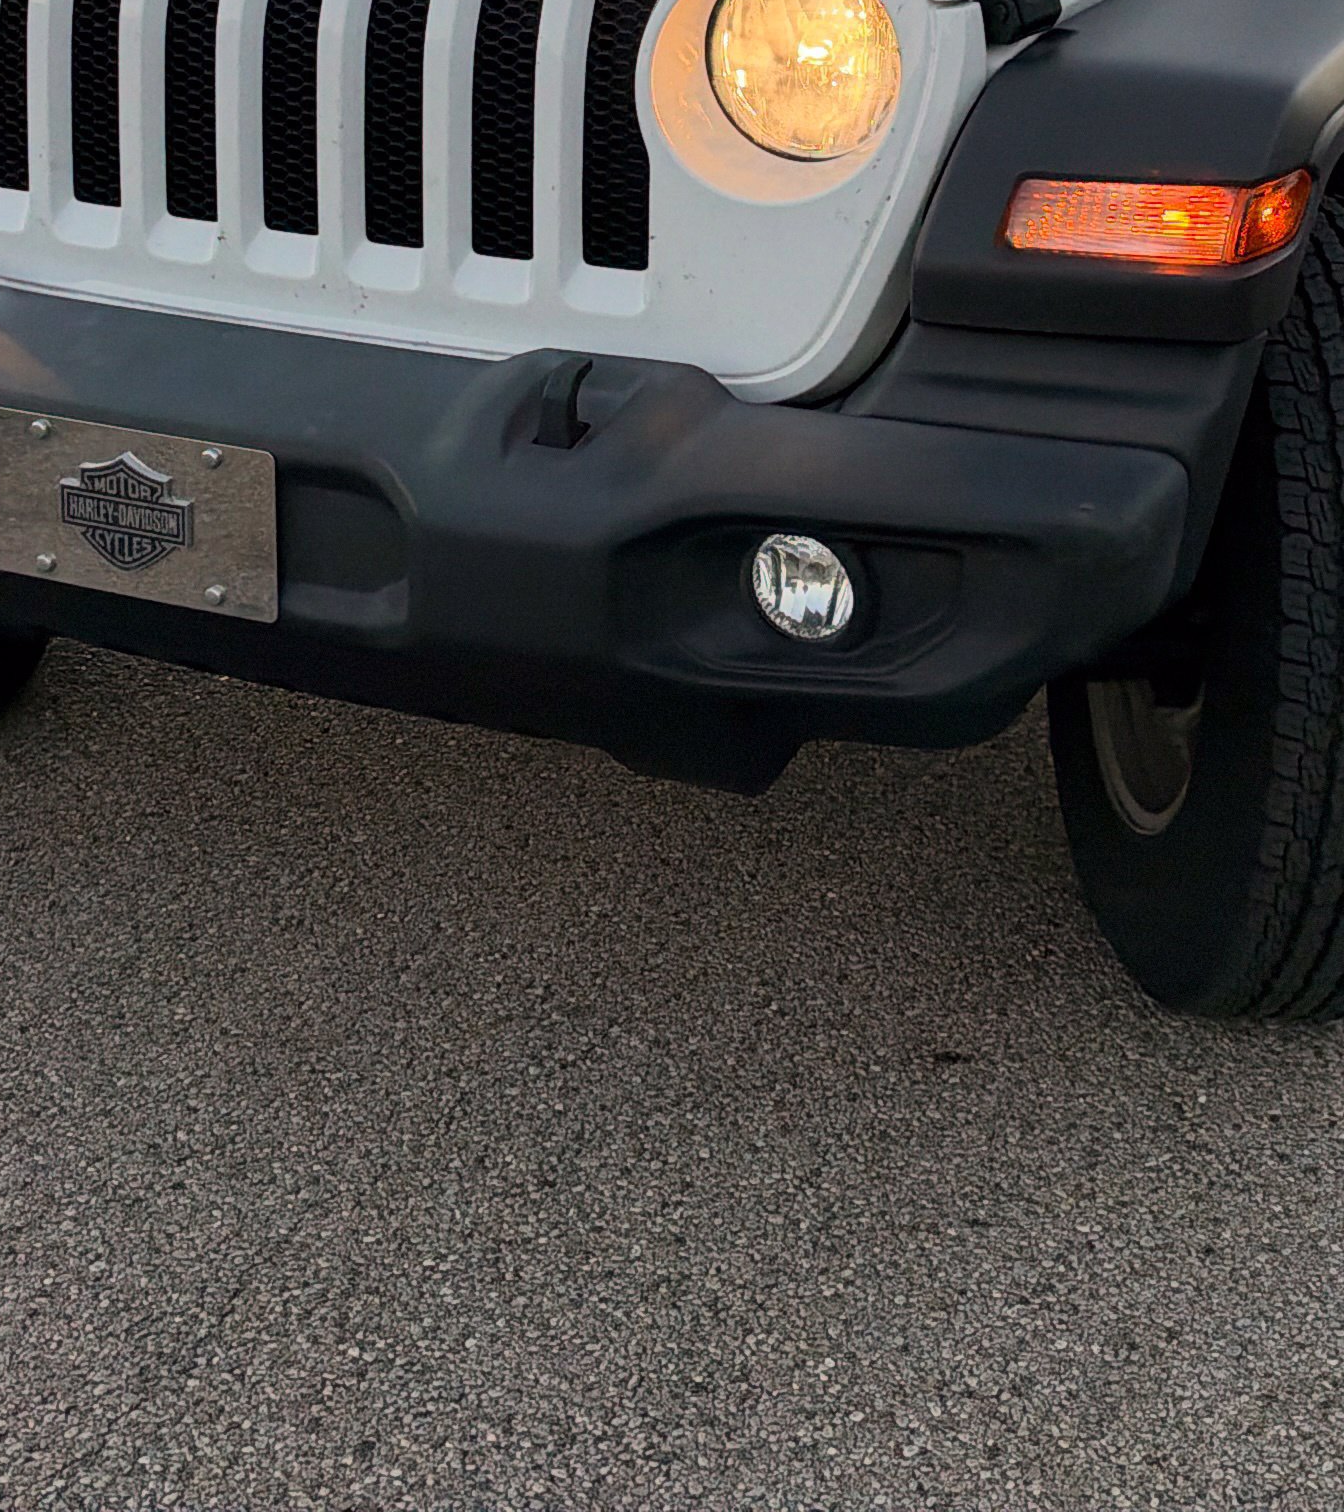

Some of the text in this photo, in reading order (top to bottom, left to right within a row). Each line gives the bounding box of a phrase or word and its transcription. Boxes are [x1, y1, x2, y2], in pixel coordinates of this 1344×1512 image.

[94, 472, 152, 502] MOTOR
[69, 494, 178, 536] HARLEY-DAVIDSON
[95, 528, 152, 562] CYCLES
